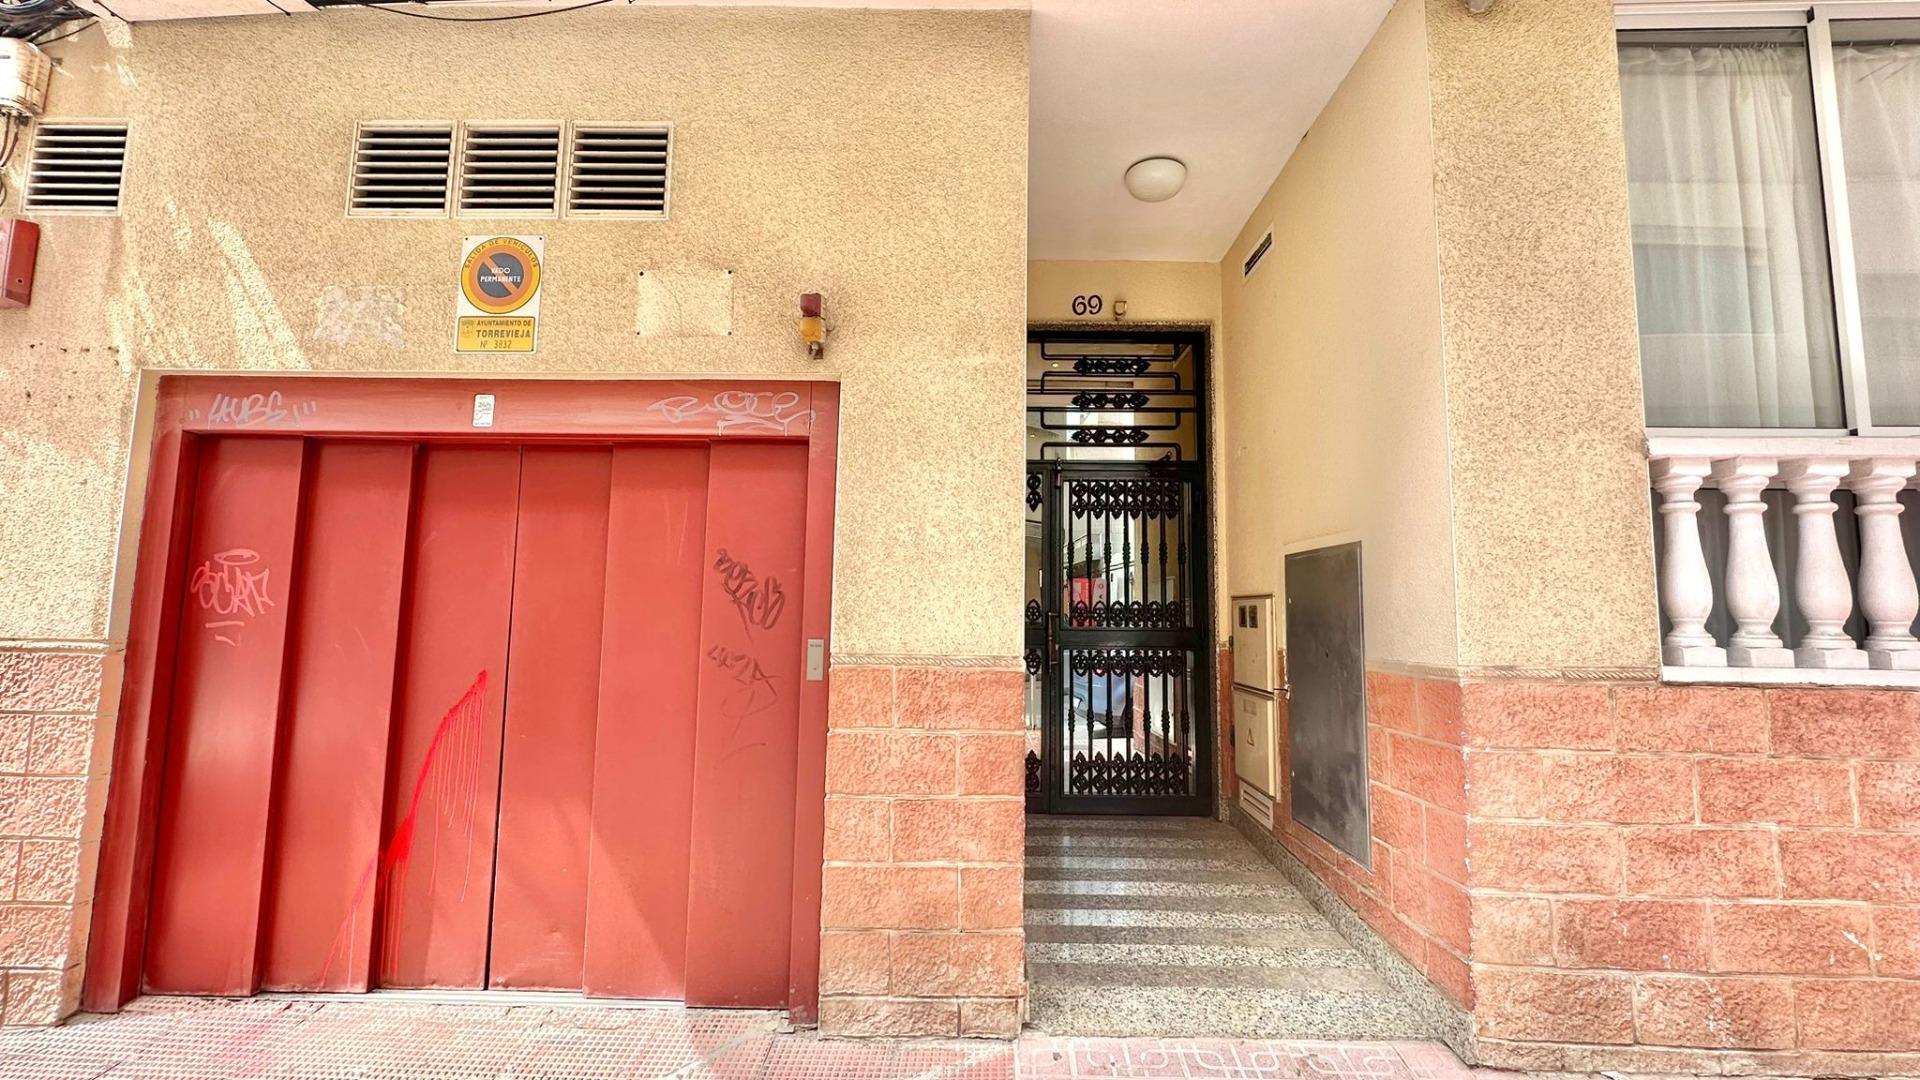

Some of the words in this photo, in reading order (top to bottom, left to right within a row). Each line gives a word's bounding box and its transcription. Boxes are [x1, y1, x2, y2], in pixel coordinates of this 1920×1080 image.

[465, 245, 487, 268] SALIDA
[503, 240, 538, 268] VEHICULOS
[1072, 294, 1103, 316] 69
[477, 319, 521, 327] AYUNTAMIENTO
[523, 319, 532, 327] DE
[476, 329, 532, 338] TORREVIEJA
